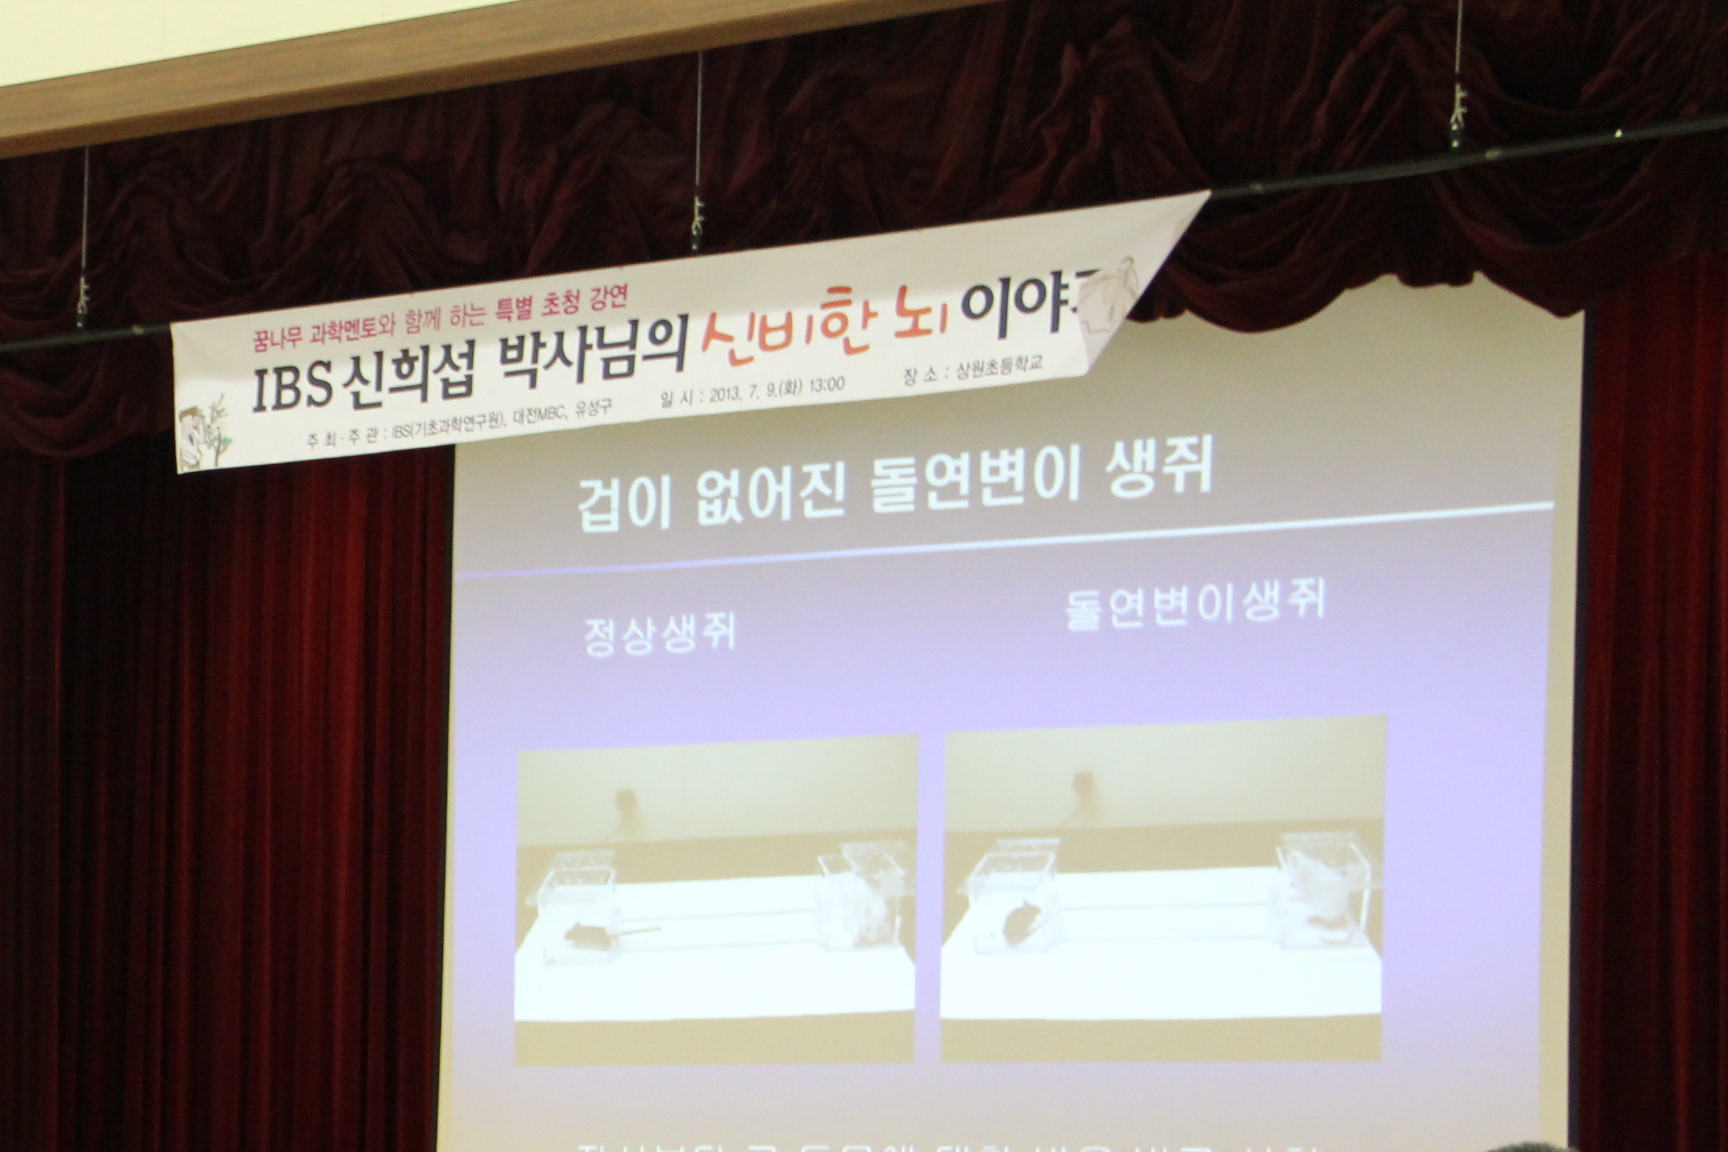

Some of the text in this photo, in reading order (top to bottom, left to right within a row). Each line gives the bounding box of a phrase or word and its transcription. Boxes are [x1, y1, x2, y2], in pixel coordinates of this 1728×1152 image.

[253, 282, 628, 354] 꿈나무 과학멘토와 함께 하는 특별 초청 강연
[342, 338, 476, 412] 신희섭
[498, 312, 690, 392] 박사님의
[701, 285, 879, 368] 신비한
[893, 283, 949, 340] 뇌
[956, 354, 1043, 381] 상원초등학교
[575, 397, 613, 419] 유성구
[809, 375, 846, 393] 13:00
[576, 433, 1214, 534] 겁이 없어진 돌연변이 생쥐
[1064, 576, 1328, 632] 돌연변이생쥐
[584, 609, 738, 659] 정상생쥐
